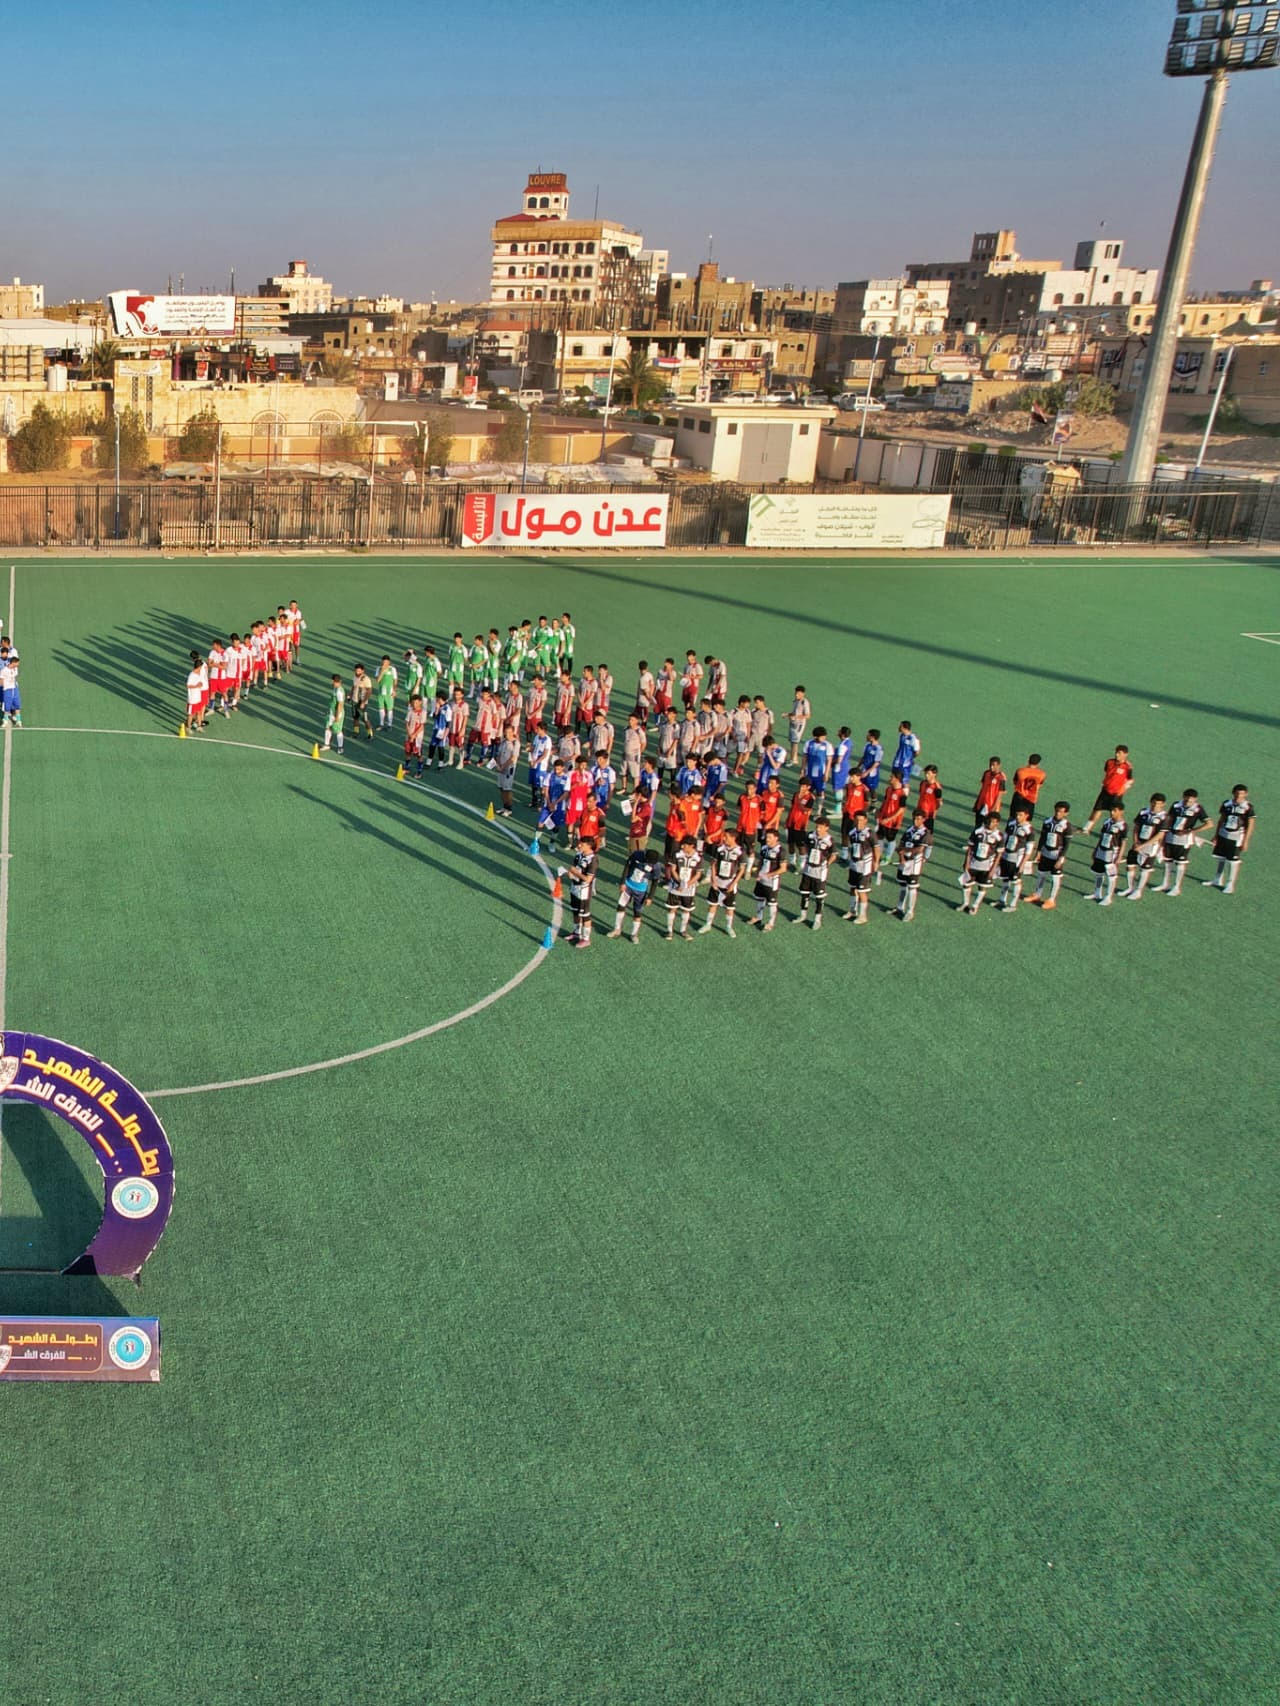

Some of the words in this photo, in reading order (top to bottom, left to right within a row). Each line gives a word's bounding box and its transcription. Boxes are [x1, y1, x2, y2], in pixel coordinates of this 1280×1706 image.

[501, 498, 582, 540] مول
[593, 501, 662, 537] عدن
[22, 1048, 106, 1097] الشهيد
[98, 1089, 161, 1176] بطولة
[8, 1332, 48, 1346] الشهيد
[49, 1334, 98, 1347] بطولة
